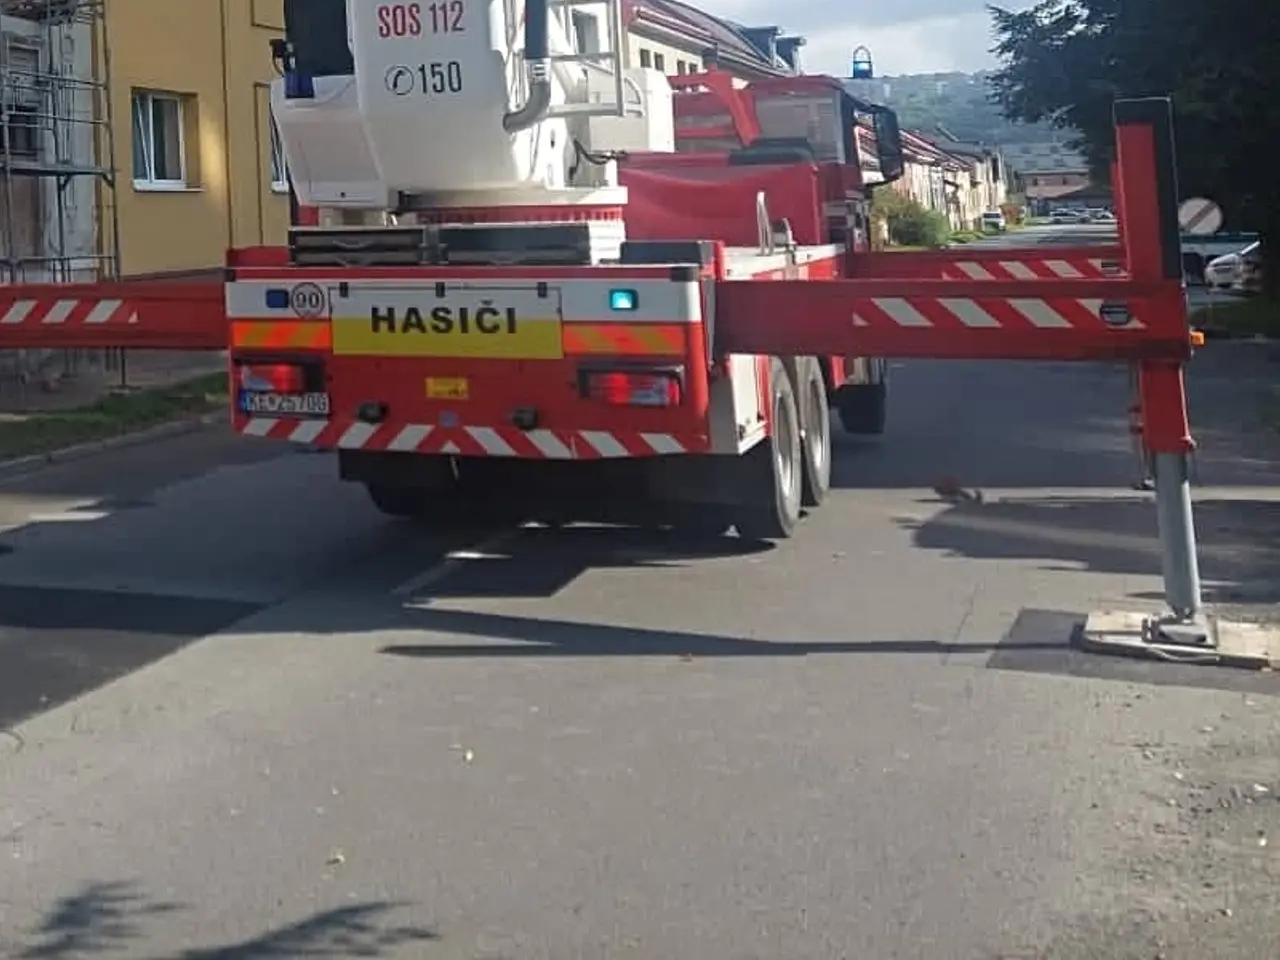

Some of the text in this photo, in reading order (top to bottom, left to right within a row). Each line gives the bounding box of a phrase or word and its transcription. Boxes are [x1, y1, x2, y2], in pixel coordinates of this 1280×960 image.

[378, 0, 465, 38] SOS 112
[419, 61, 462, 93] 150
[371, 299, 517, 334] HASIČI
